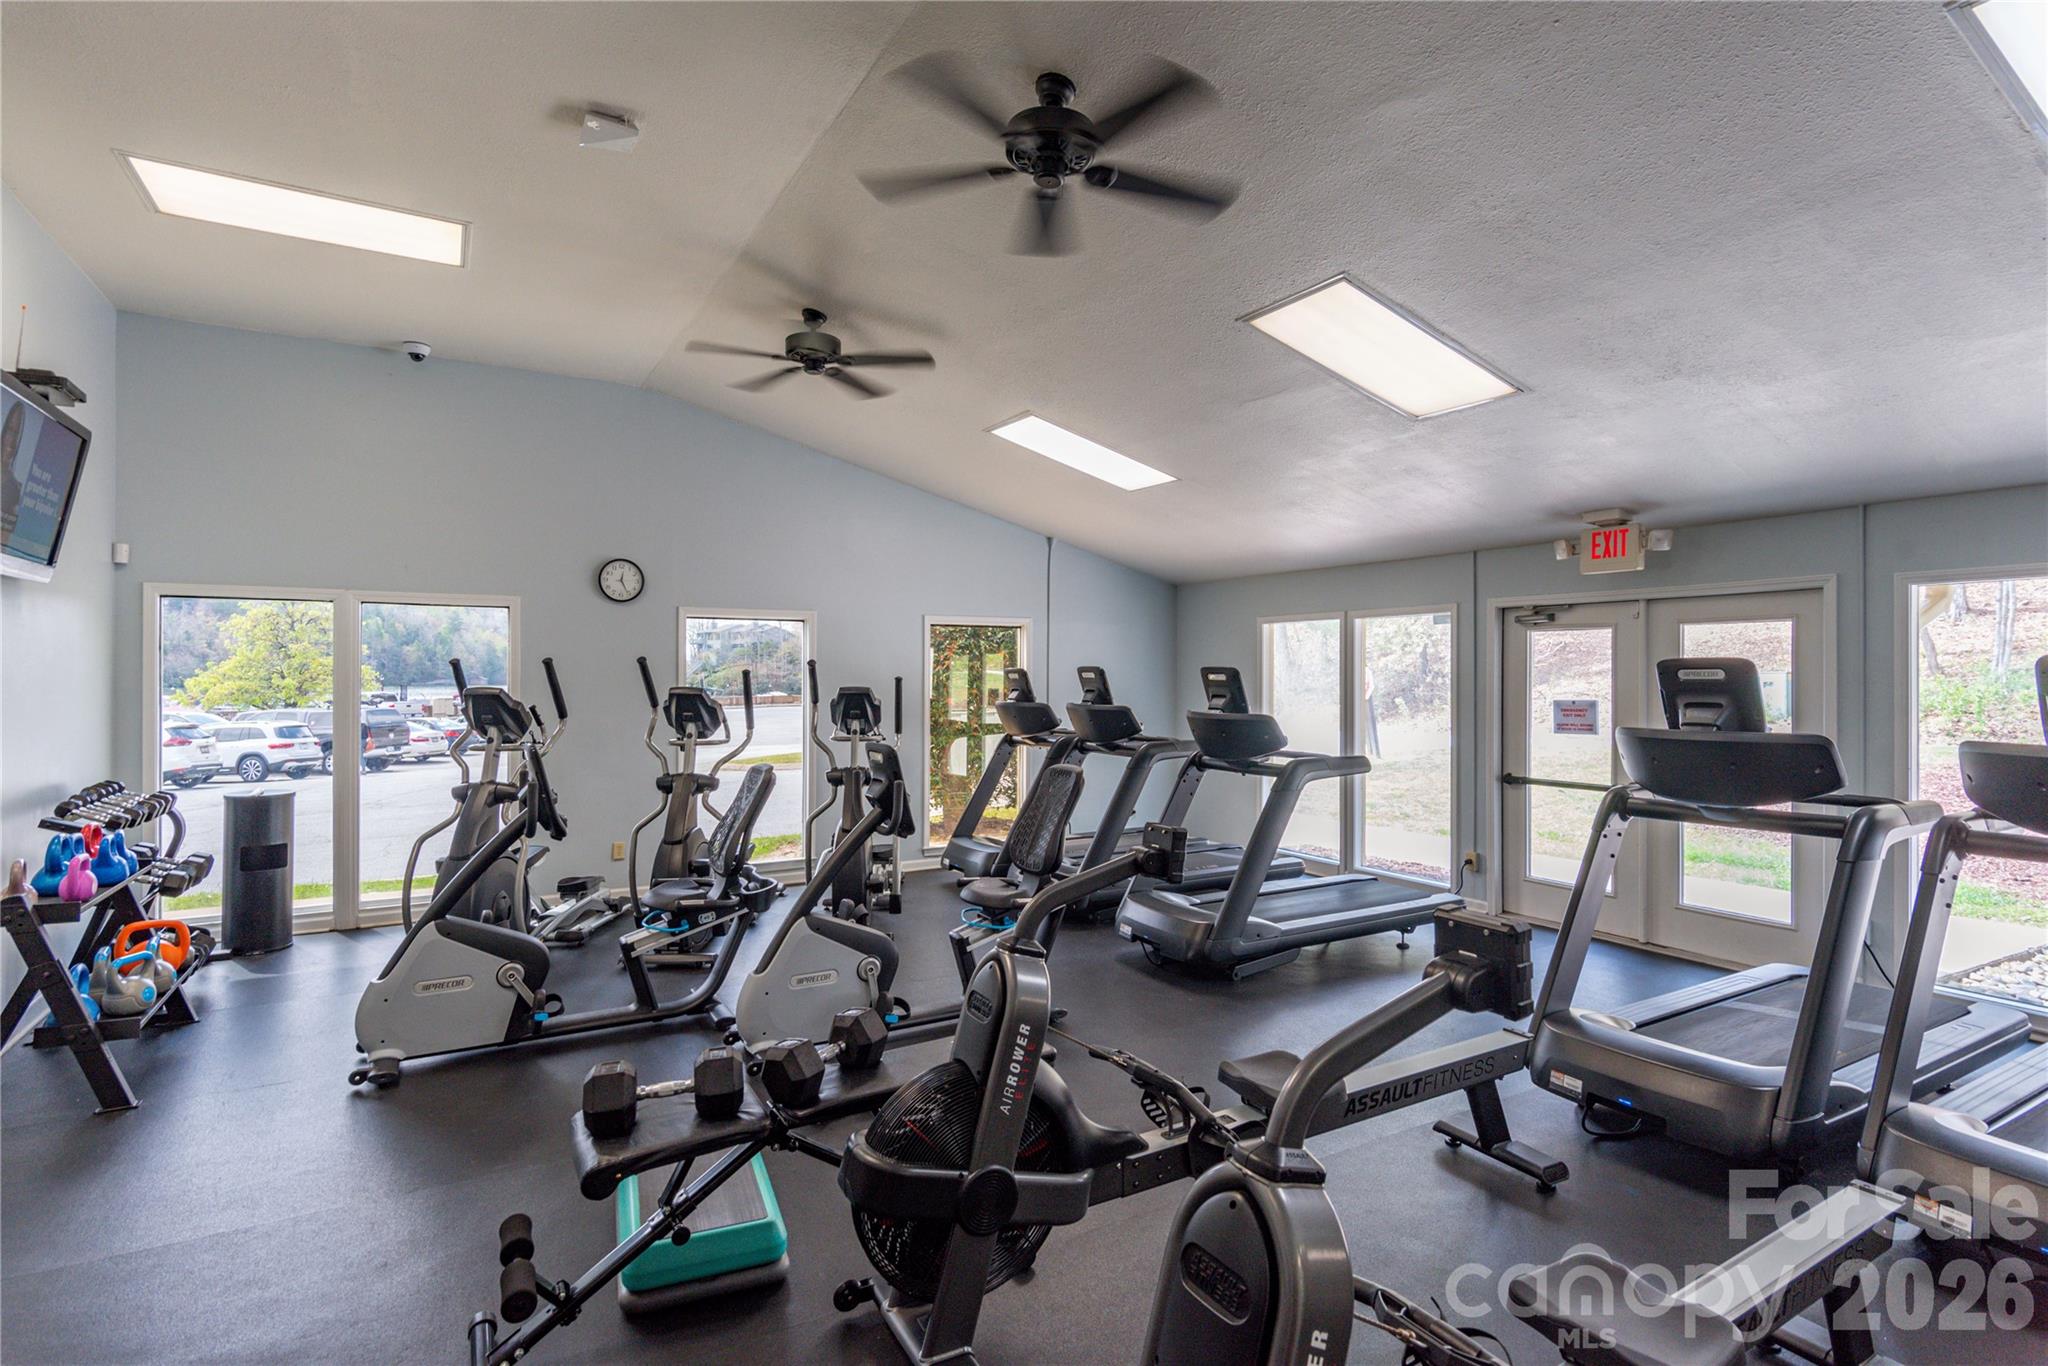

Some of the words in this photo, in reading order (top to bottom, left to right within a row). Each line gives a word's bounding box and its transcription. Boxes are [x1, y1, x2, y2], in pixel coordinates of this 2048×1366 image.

[1591, 528, 1630, 559] EXIT
[427, 979, 465, 991] PRECOR
[801, 973, 832, 984] PRECOR
[1000, 1023, 1031, 1116] AIRROWER
[1344, 1056, 1496, 1118] ASSAULTFITNESS
